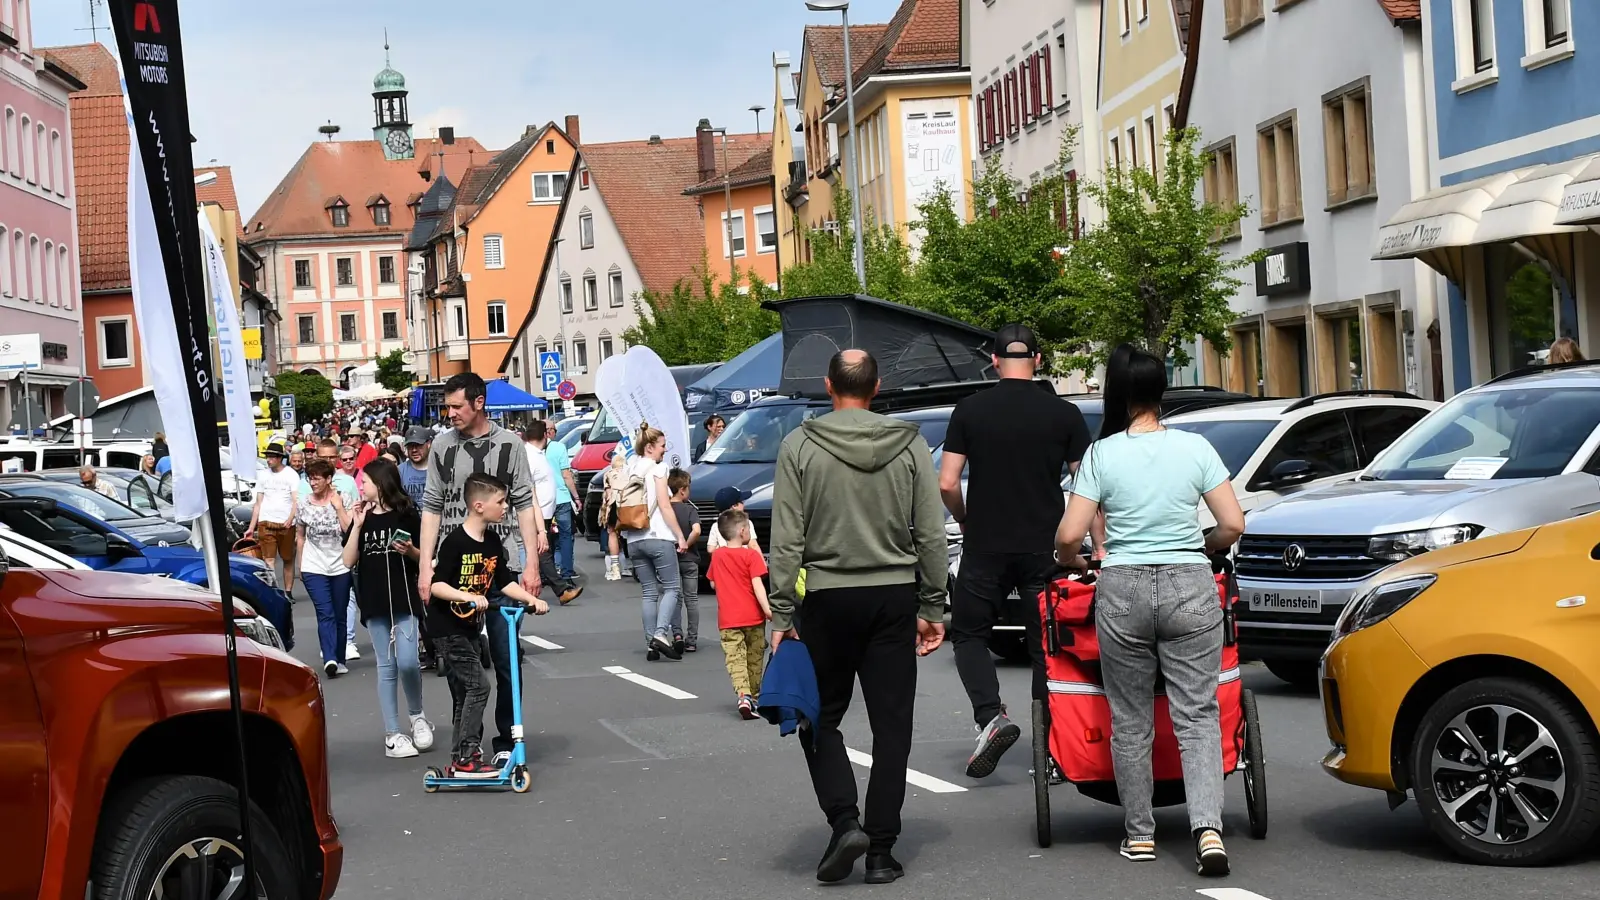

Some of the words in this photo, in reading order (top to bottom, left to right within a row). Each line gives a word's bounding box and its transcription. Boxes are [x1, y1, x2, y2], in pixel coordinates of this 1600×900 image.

[133, 41, 169, 63] MITSUBISHI
[139, 64, 169, 84] MOTORS
[546, 374, 557, 390] P
[461, 553, 483, 565] SKATE
[458, 574, 489, 585] STREETS
[1264, 593, 1318, 609] Pillenstein
